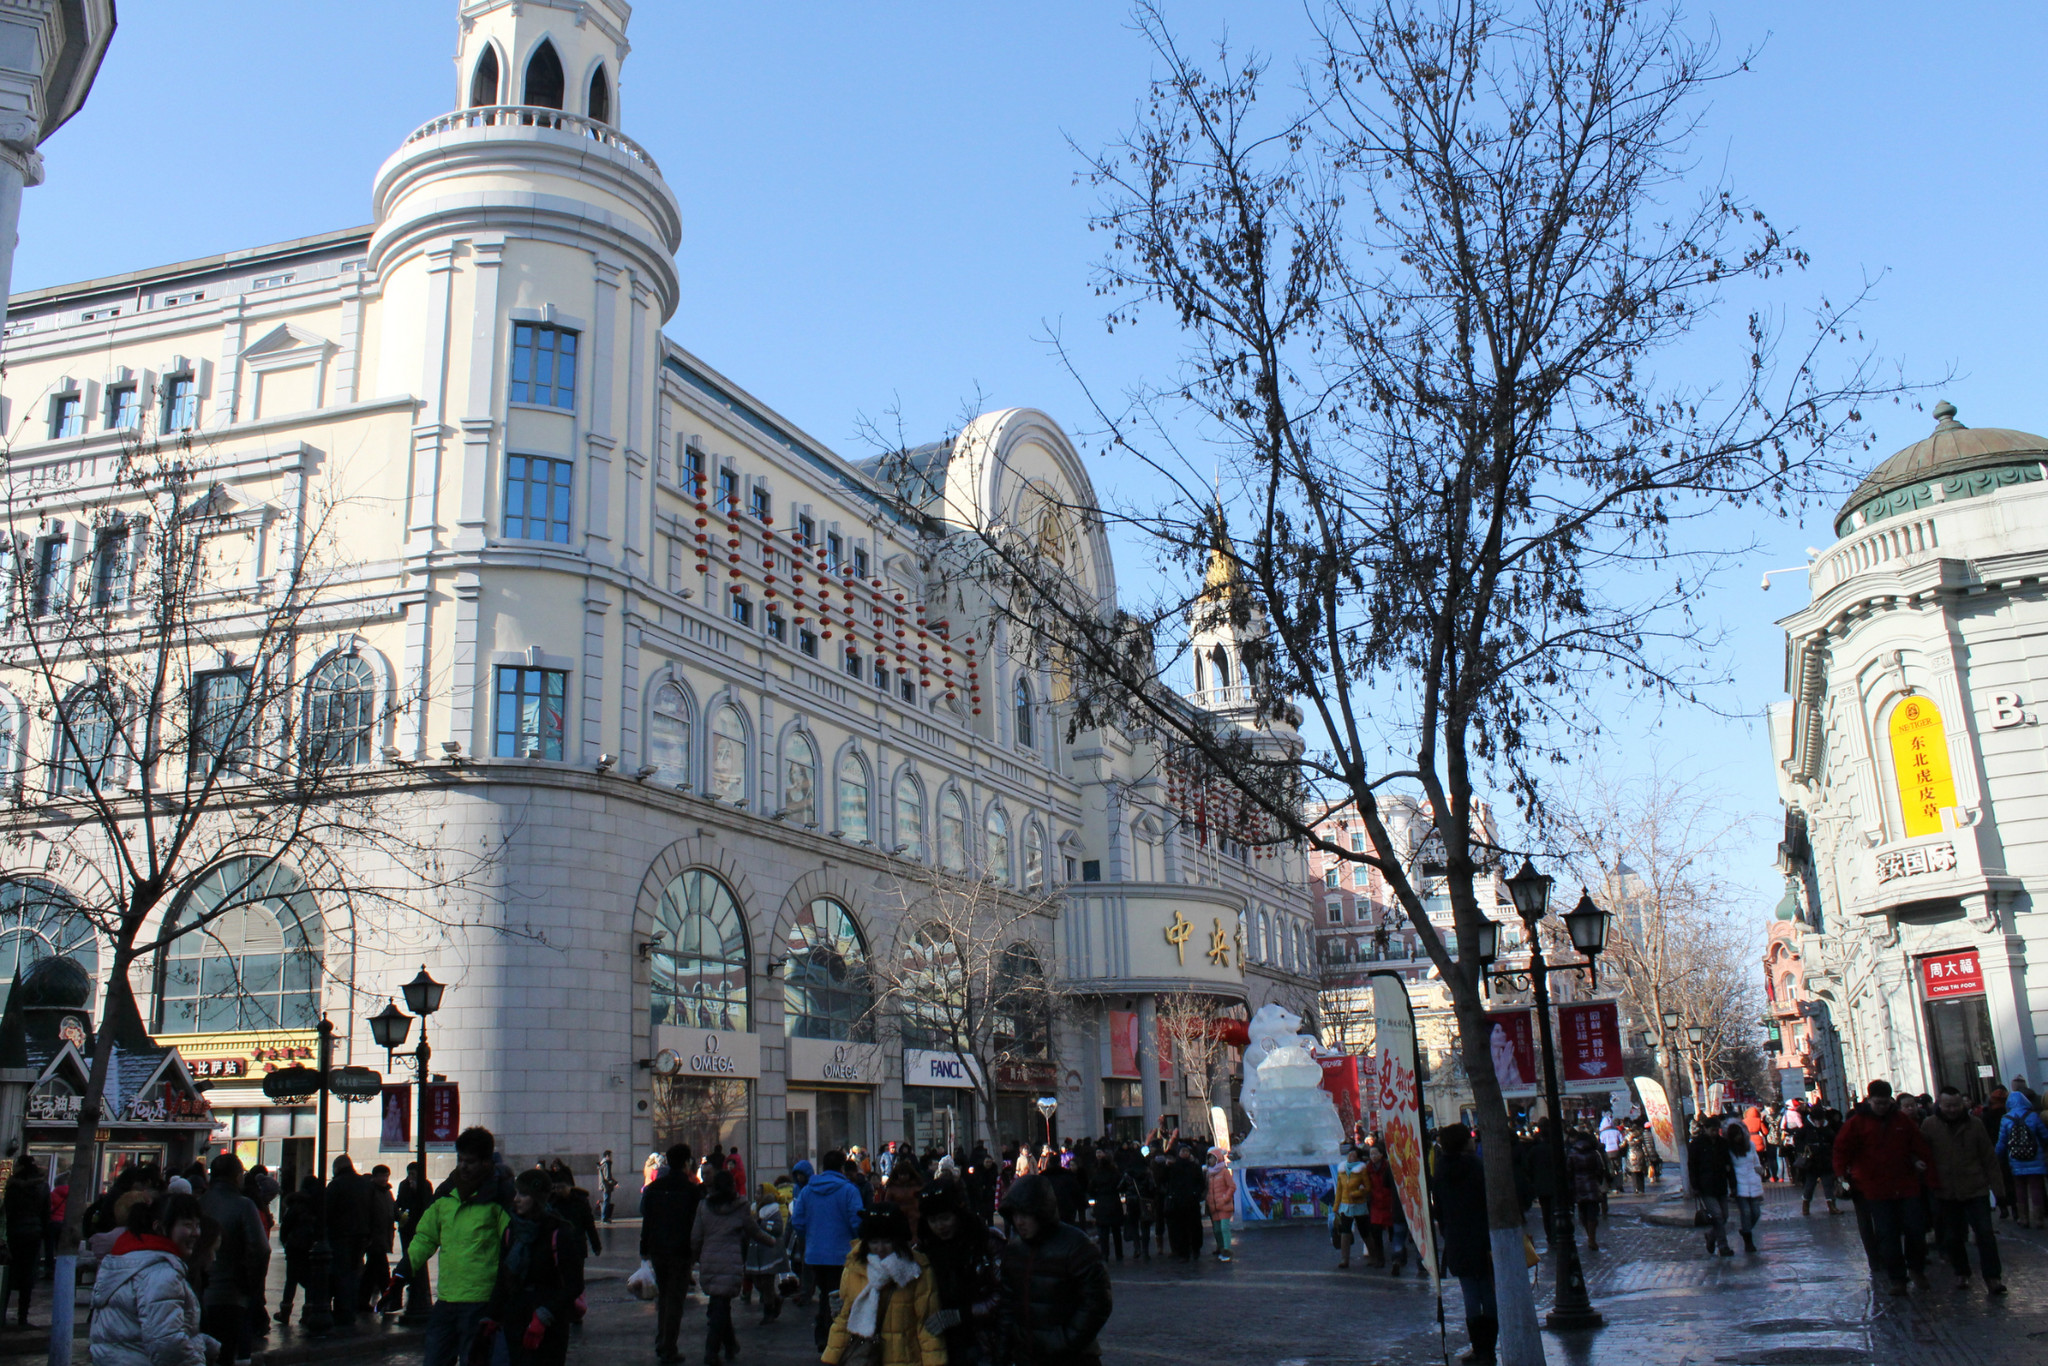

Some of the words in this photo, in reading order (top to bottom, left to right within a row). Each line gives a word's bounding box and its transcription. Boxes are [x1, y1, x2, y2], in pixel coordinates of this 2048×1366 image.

[1911, 736, 1939, 818] 东北虎皮草
[1930, 958, 1974, 978] 周大福
[691, 1054, 735, 1073] OMEGA
[824, 1064, 858, 1079] OMEGA
[931, 1060, 963, 1079] FANCL
